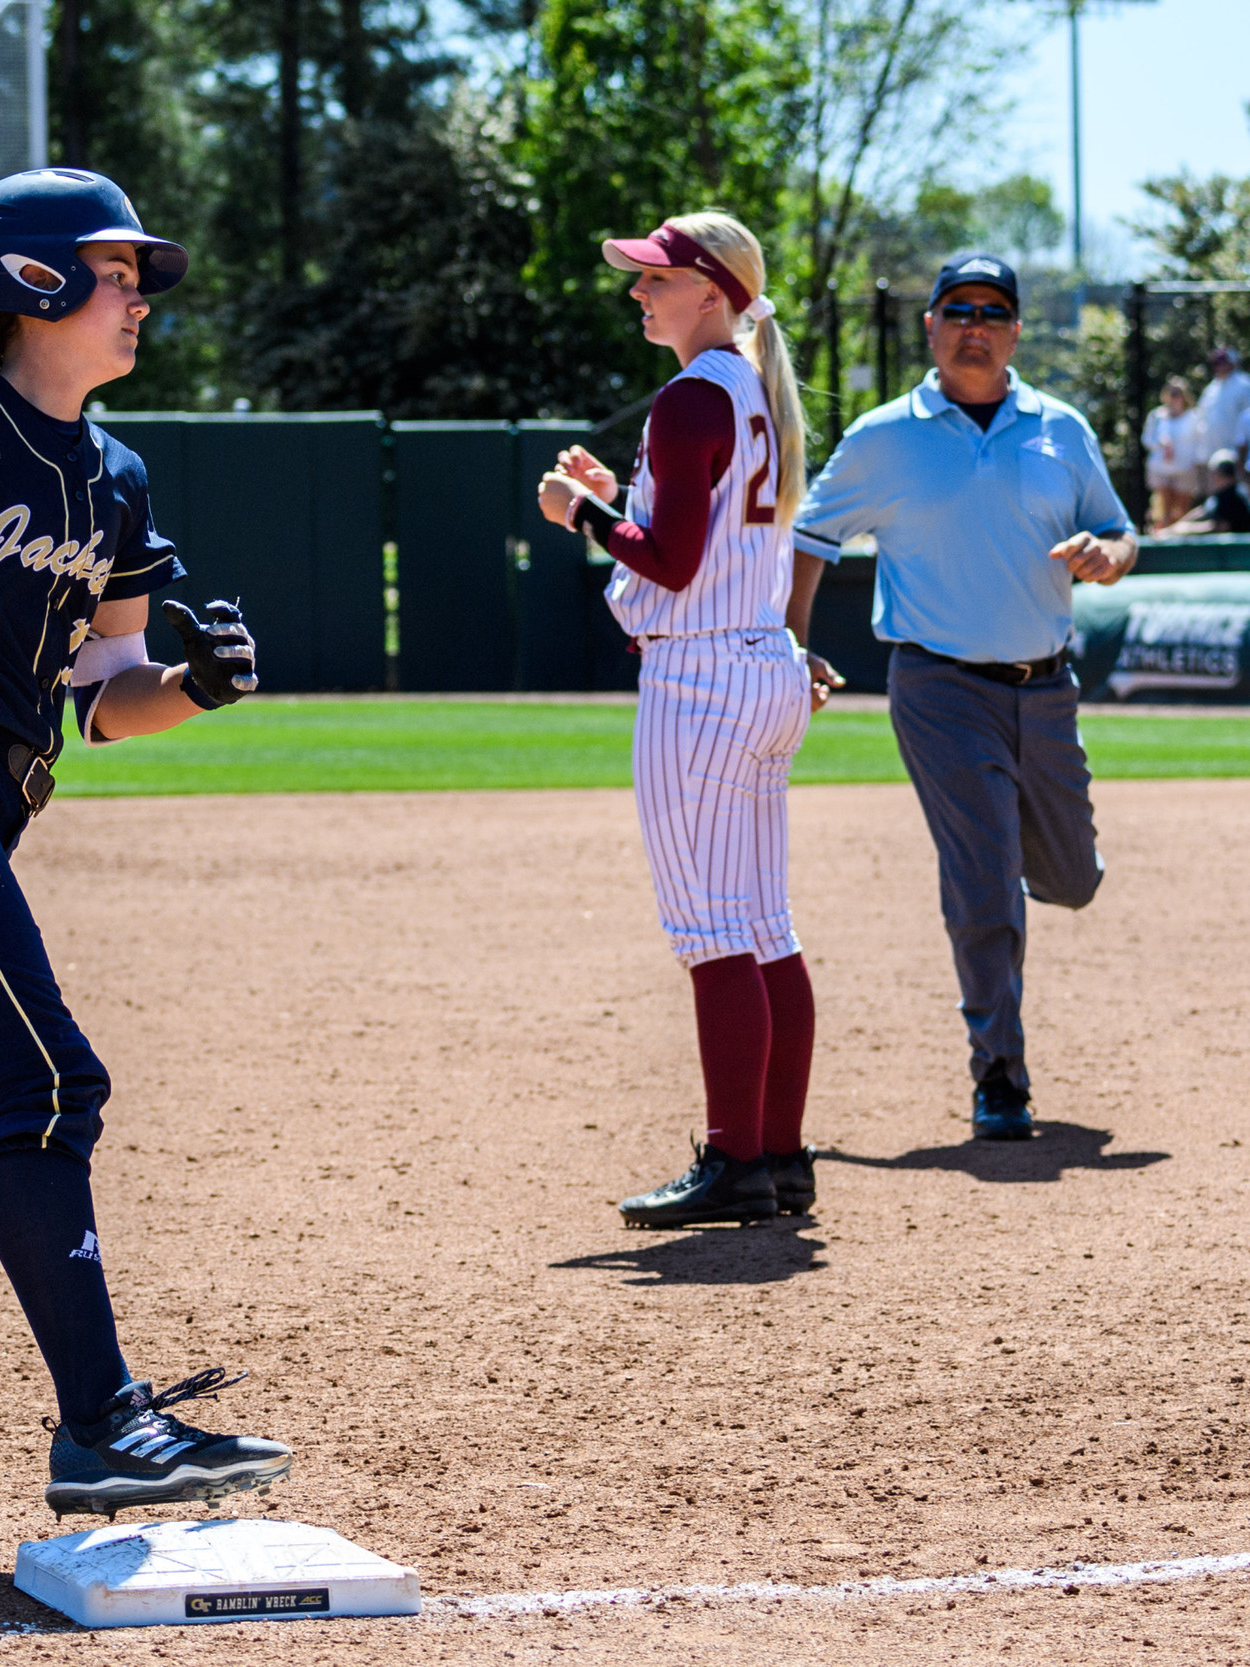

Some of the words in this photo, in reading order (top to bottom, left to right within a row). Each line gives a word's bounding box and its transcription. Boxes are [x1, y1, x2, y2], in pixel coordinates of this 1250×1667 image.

[742, 412, 777, 527] 2
[1116, 646, 1236, 674] ATHLETICS
[265, 1595, 297, 1608] WRECK
[300, 1595, 323, 1603] ACC
